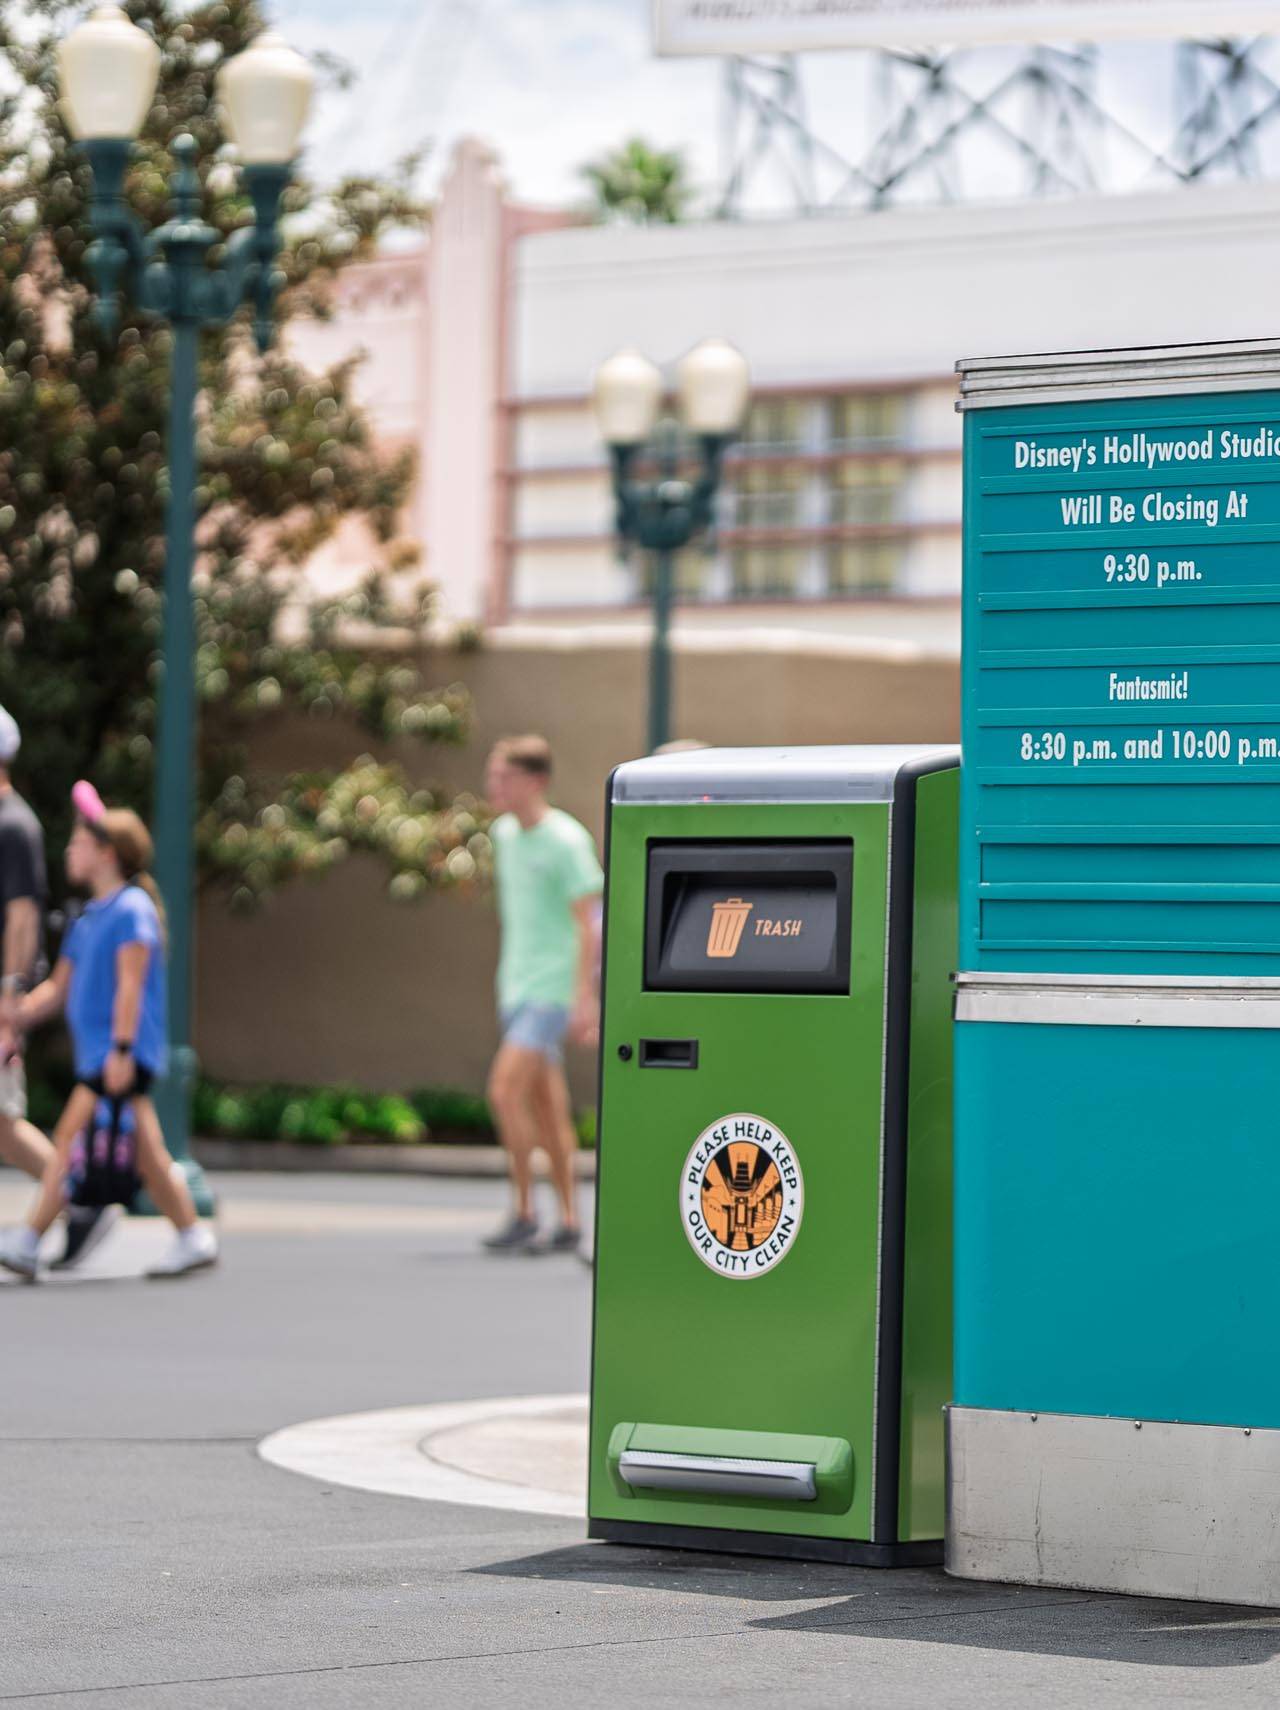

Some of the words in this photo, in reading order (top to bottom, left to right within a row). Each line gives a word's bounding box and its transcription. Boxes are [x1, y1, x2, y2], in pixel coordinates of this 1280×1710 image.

[1015, 438, 1097, 473] Disney's
[1103, 430, 1213, 469] Hollywood
[1060, 494, 1102, 526] Will
[1109, 495, 1136, 523] Be
[1142, 492, 1219, 527] Closing
[1225, 490, 1248, 519] At
[1103, 553, 1150, 582] 9:30
[1157, 560, 1202, 588] p.m.
[1109, 671, 1188, 701] Fantasmic!
[1020, 732, 1066, 761] 8:30
[1073, 740, 1117, 767] p.m.
[1123, 729, 1163, 760] and
[1172, 729, 1231, 759] 10:00
[754, 919, 802, 936] TRASH
[688, 1126, 730, 1185] PLEASE
[734, 1121, 772, 1143] HELP
[772, 1141, 797, 1190] KEEP
[688, 1210, 713, 1254] OUR
[715, 1250, 749, 1272] CITY
[755, 1215, 795, 1266] CLEAN
